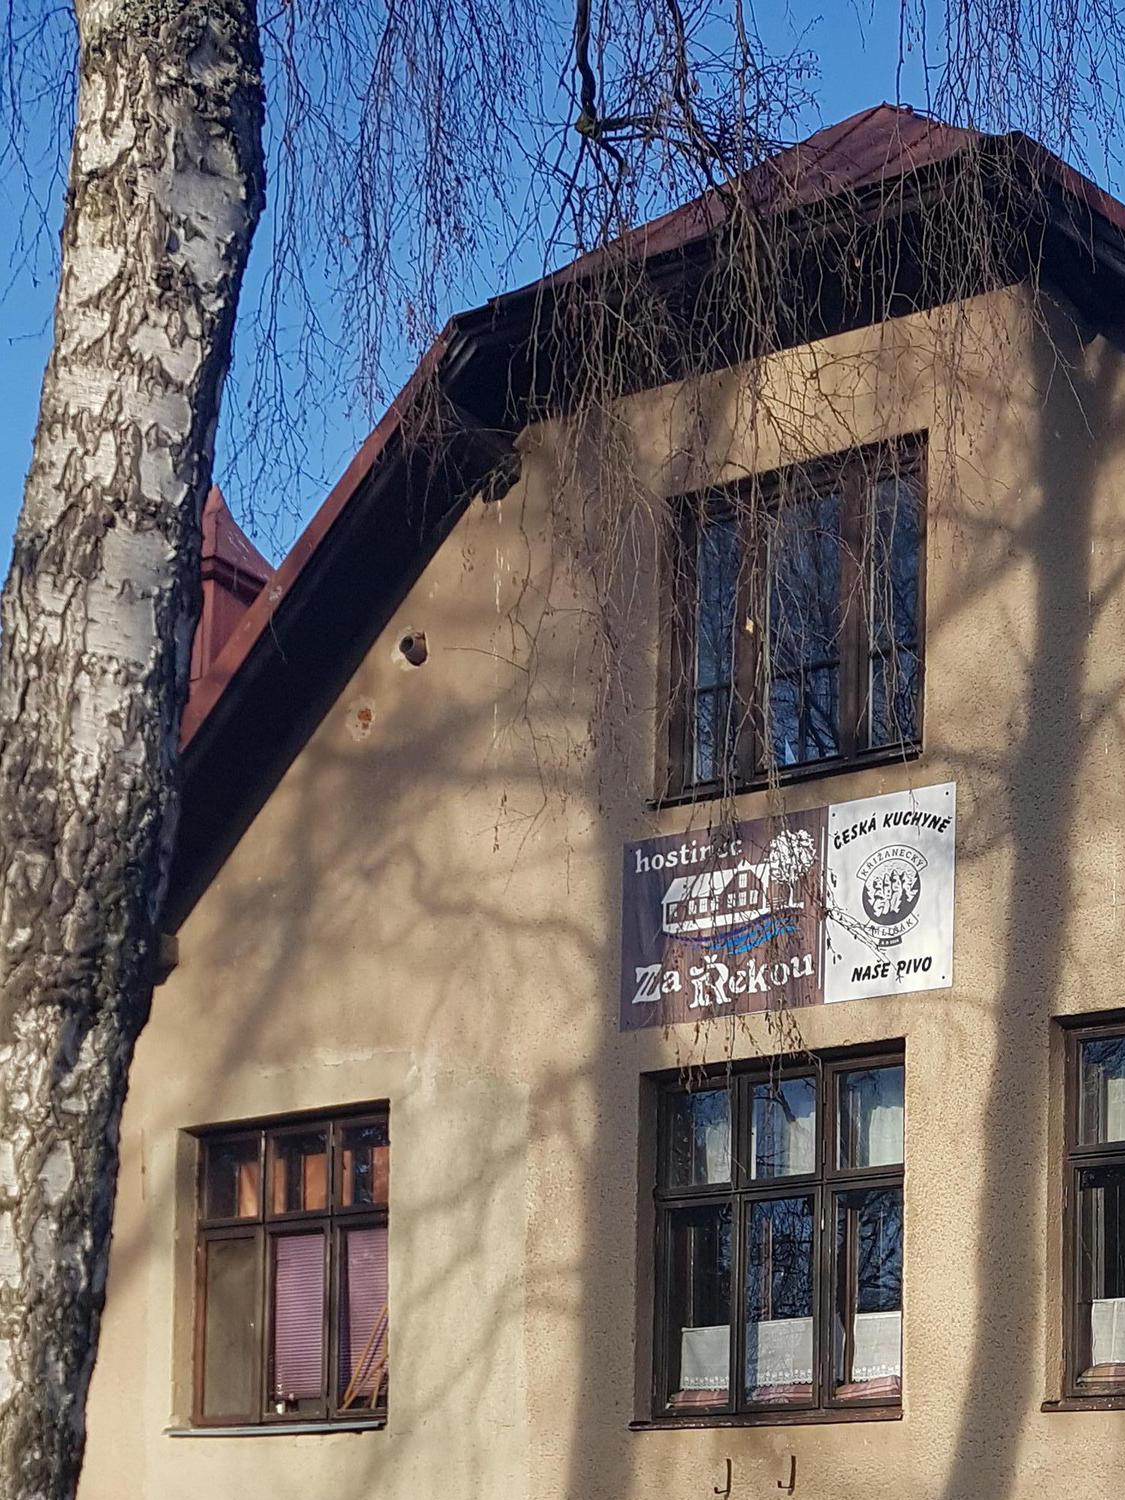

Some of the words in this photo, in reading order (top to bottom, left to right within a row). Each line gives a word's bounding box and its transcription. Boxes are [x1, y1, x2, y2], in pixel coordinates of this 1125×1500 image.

[833, 812, 877, 850] ČESKÁ
[882, 811, 953, 834] KUCHYNĚ
[632, 963, 683, 1005] Za
[689, 954, 816, 1009] Řekou
[851, 960, 891, 983] NAŠE
[896, 956, 933, 976] PIVO
